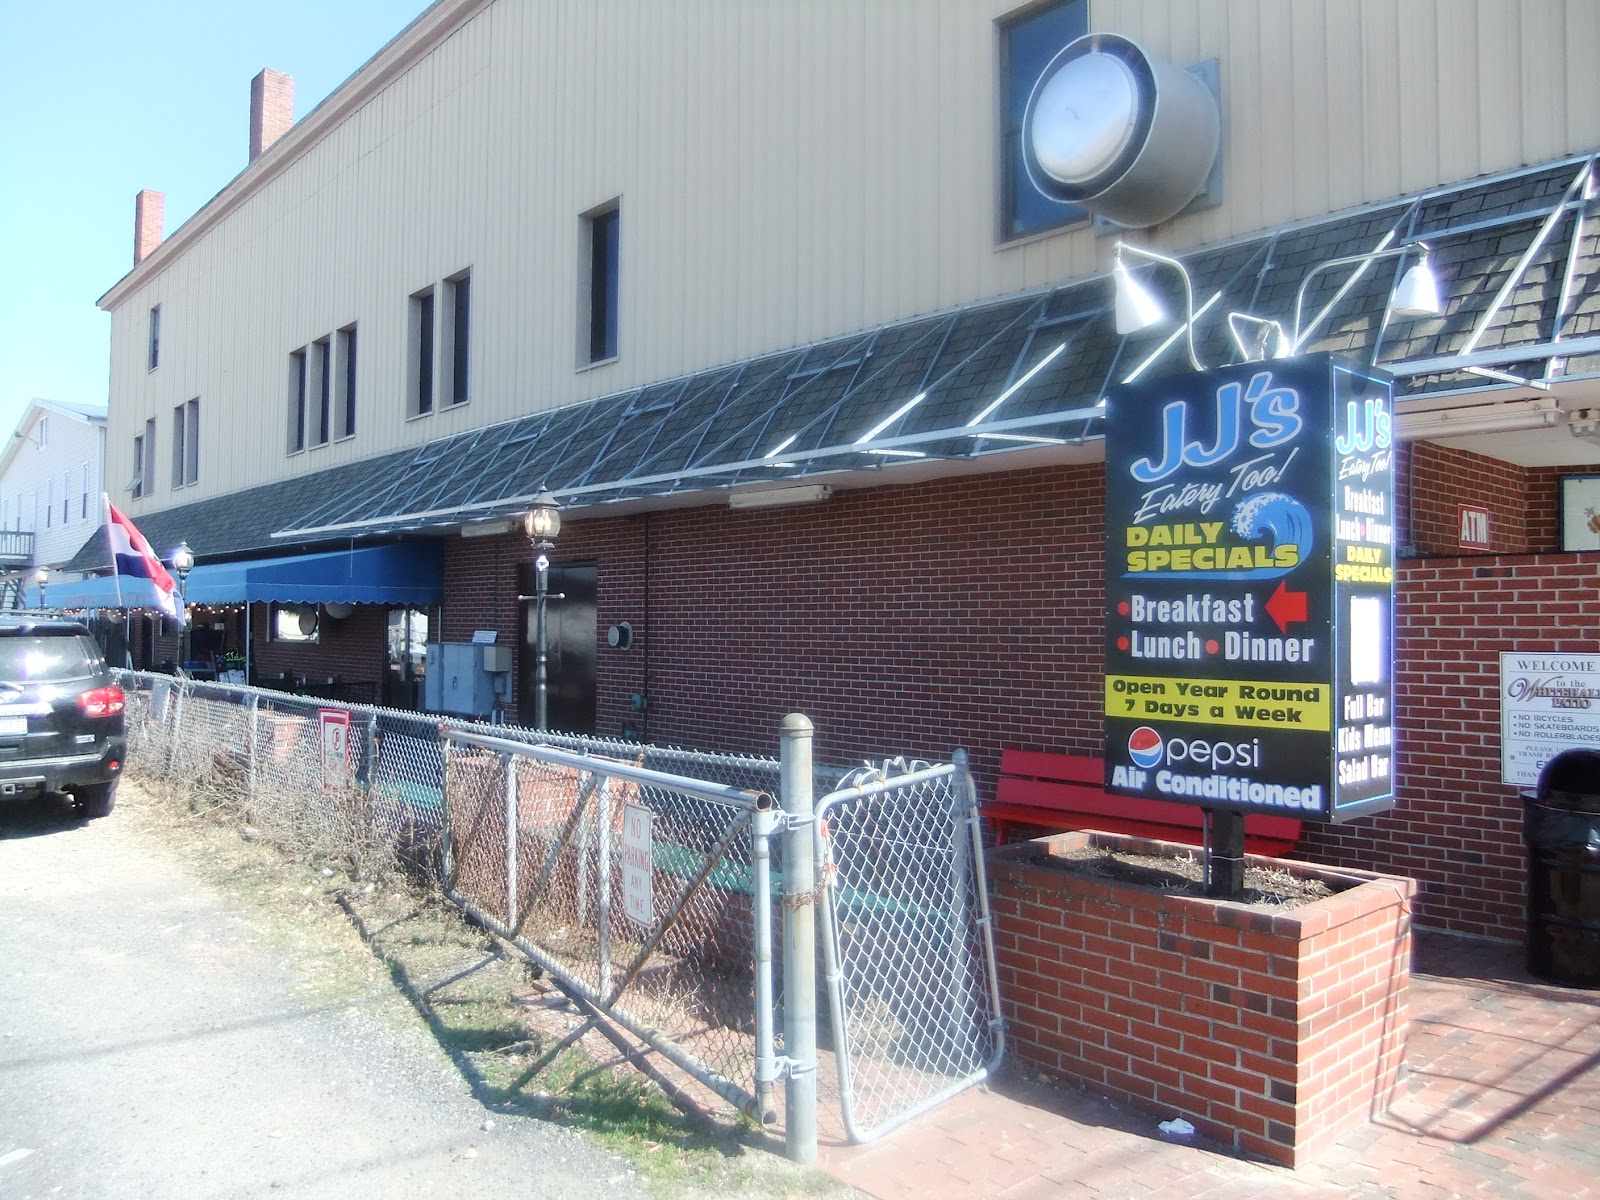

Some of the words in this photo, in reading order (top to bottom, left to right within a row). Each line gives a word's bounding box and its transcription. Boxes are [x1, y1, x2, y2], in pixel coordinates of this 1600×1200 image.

[1130, 371, 1302, 483] JJ's
[1335, 398, 1391, 455] JJ's
[1338, 456, 1371, 482] Eatery
[1367, 450, 1392, 474] Too!
[1132, 483, 1223, 524] Eatery
[1225, 446, 1300, 498] Too!
[1344, 485, 1384, 515] Breakfast
[1126, 521, 1224, 547] DAILY
[1336, 513, 1361, 541] Lunch
[1365, 517, 1392, 544] Dinner
[1461, 510, 1487, 543] ATM
[1127, 544, 1299, 572] SPECIALS
[1347, 545, 1381, 564] DAILY
[1335, 564, 1392, 583] SPECIALS
[1131, 593, 1254, 622] Breakfast
[1131, 630, 1200, 659] Lunch
[1224, 631, 1314, 662] Dinner
[1517, 660, 1595, 671] WELCOME
[1112, 680, 1166, 695] Open
[1175, 682, 1228, 698] Year
[1239, 685, 1320, 702] Round
[1124, 699, 1136, 711] 7
[1144, 699, 1199, 718] Days
[1209, 705, 1224, 718] a
[1234, 705, 1302, 723] Week
[1344, 695, 1363, 720] Full
[1366, 693, 1384, 717] Bar
[1534, 714, 1573, 723] BICYCLES
[1338, 727, 1361, 752] Kids
[1364, 723, 1391, 748] Menu
[1534, 722, 1599, 732] SKATEBOARDS
[1534, 731, 1600, 741] ROLLERBLADES
[1166, 737, 1259, 770] pepsi
[1339, 756, 1367, 785] Salad
[1371, 754, 1389, 778] Bar
[1111, 765, 1147, 789] Air
[1155, 770, 1321, 810] Conditioned
[631, 816, 641, 840] NO
[624, 844, 648, 872] PARKING
[631, 874, 641, 890] ANY
[630, 894, 643, 914] TIME
